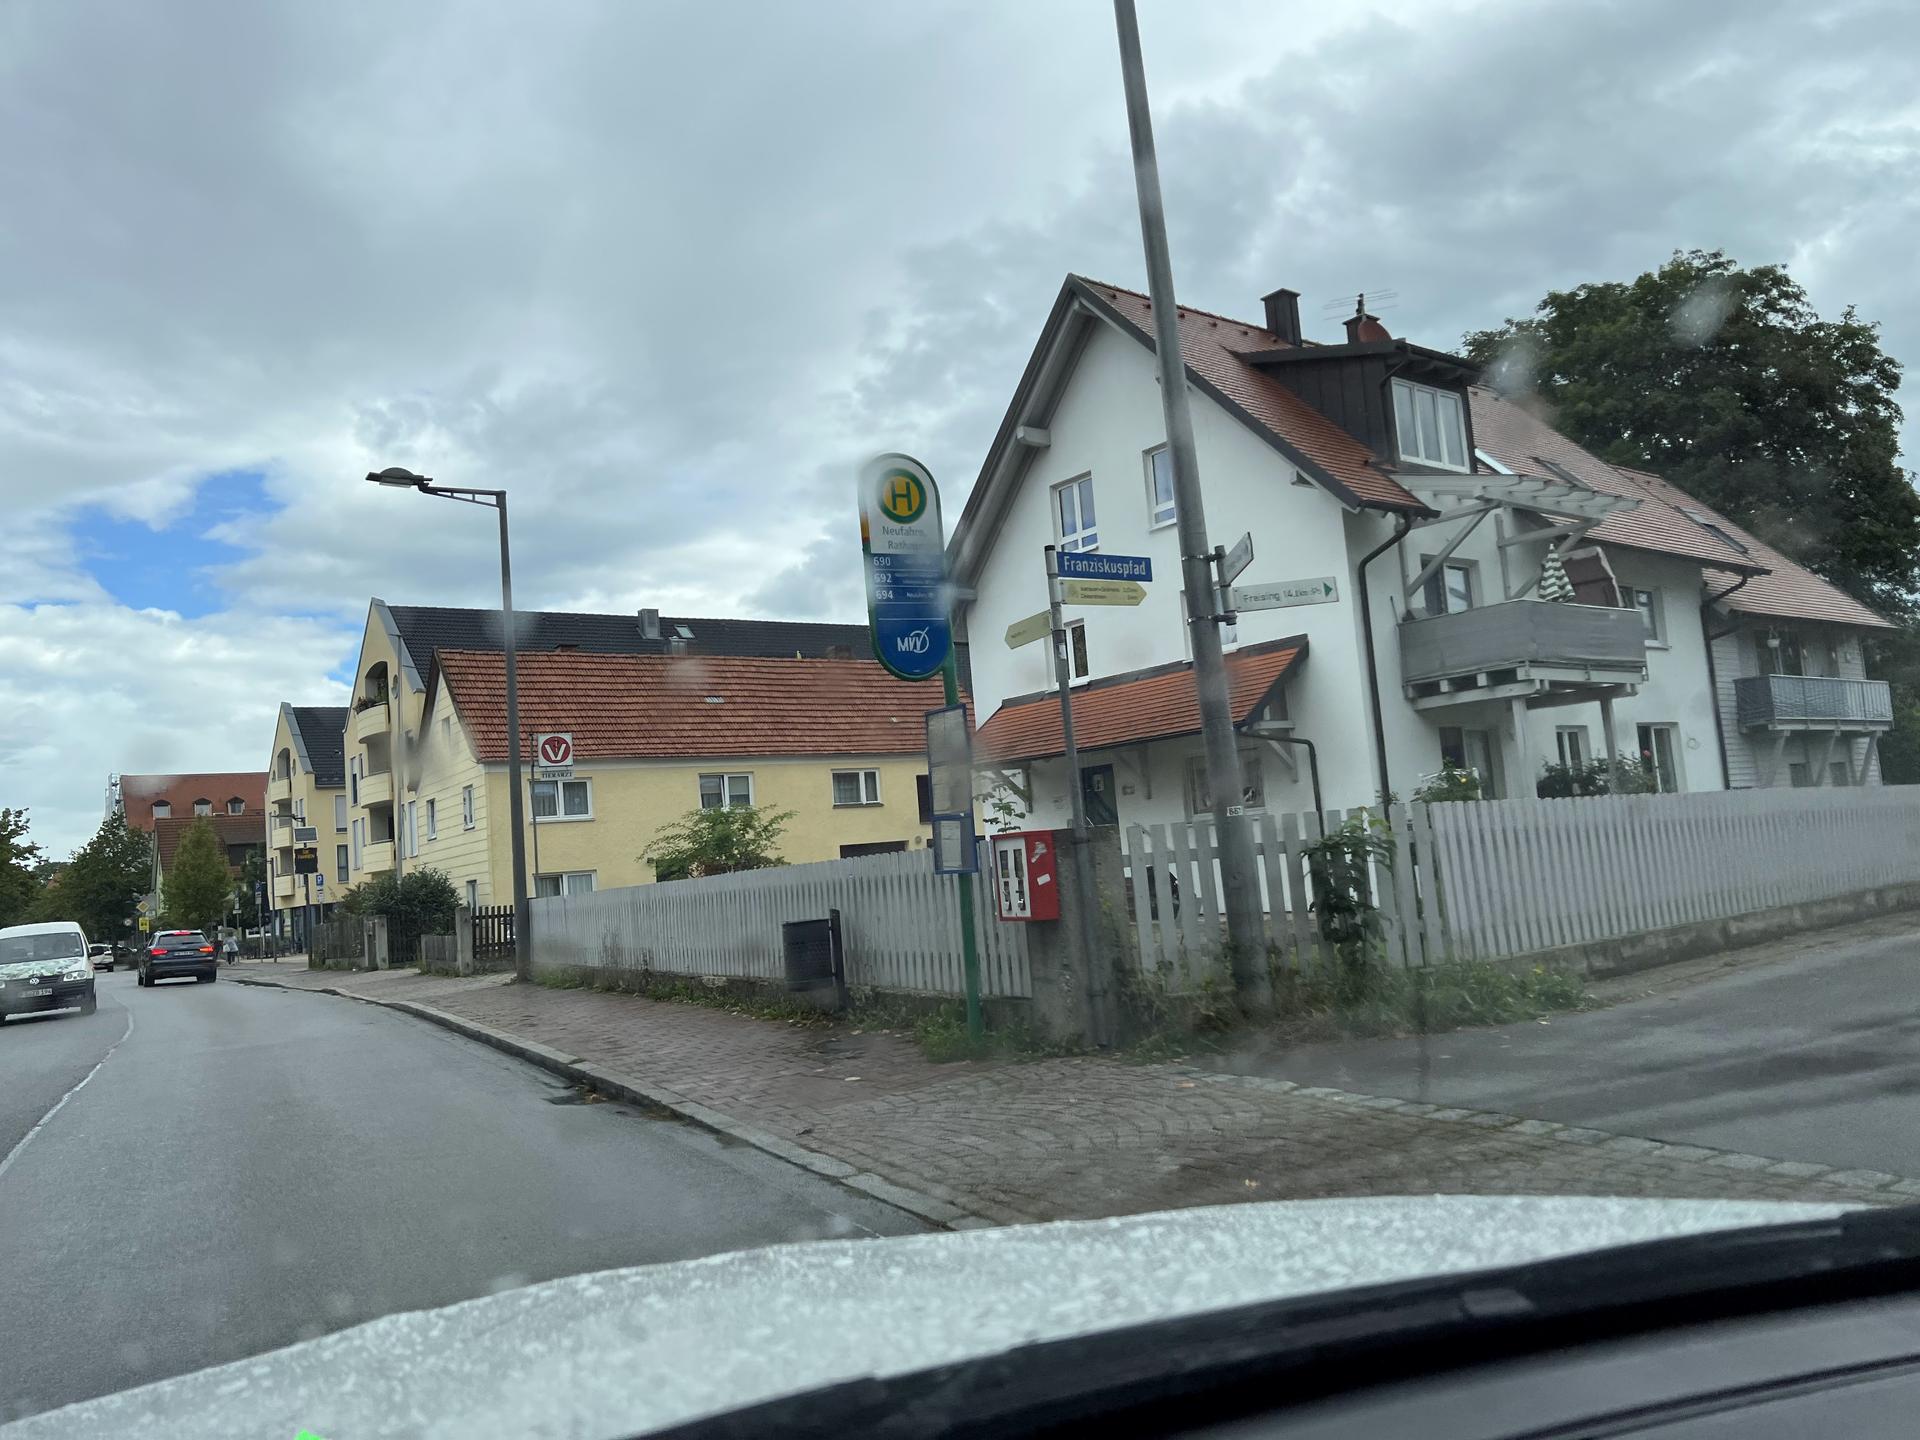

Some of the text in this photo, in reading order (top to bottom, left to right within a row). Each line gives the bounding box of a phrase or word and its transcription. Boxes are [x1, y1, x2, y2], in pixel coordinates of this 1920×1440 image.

[891, 480, 912, 511] H
[888, 540, 924, 550] Rath
[873, 557, 891, 566] 690
[1064, 556, 1147, 577] Franziskuspfad
[874, 573, 892, 583] 692
[876, 590, 893, 599] 694
